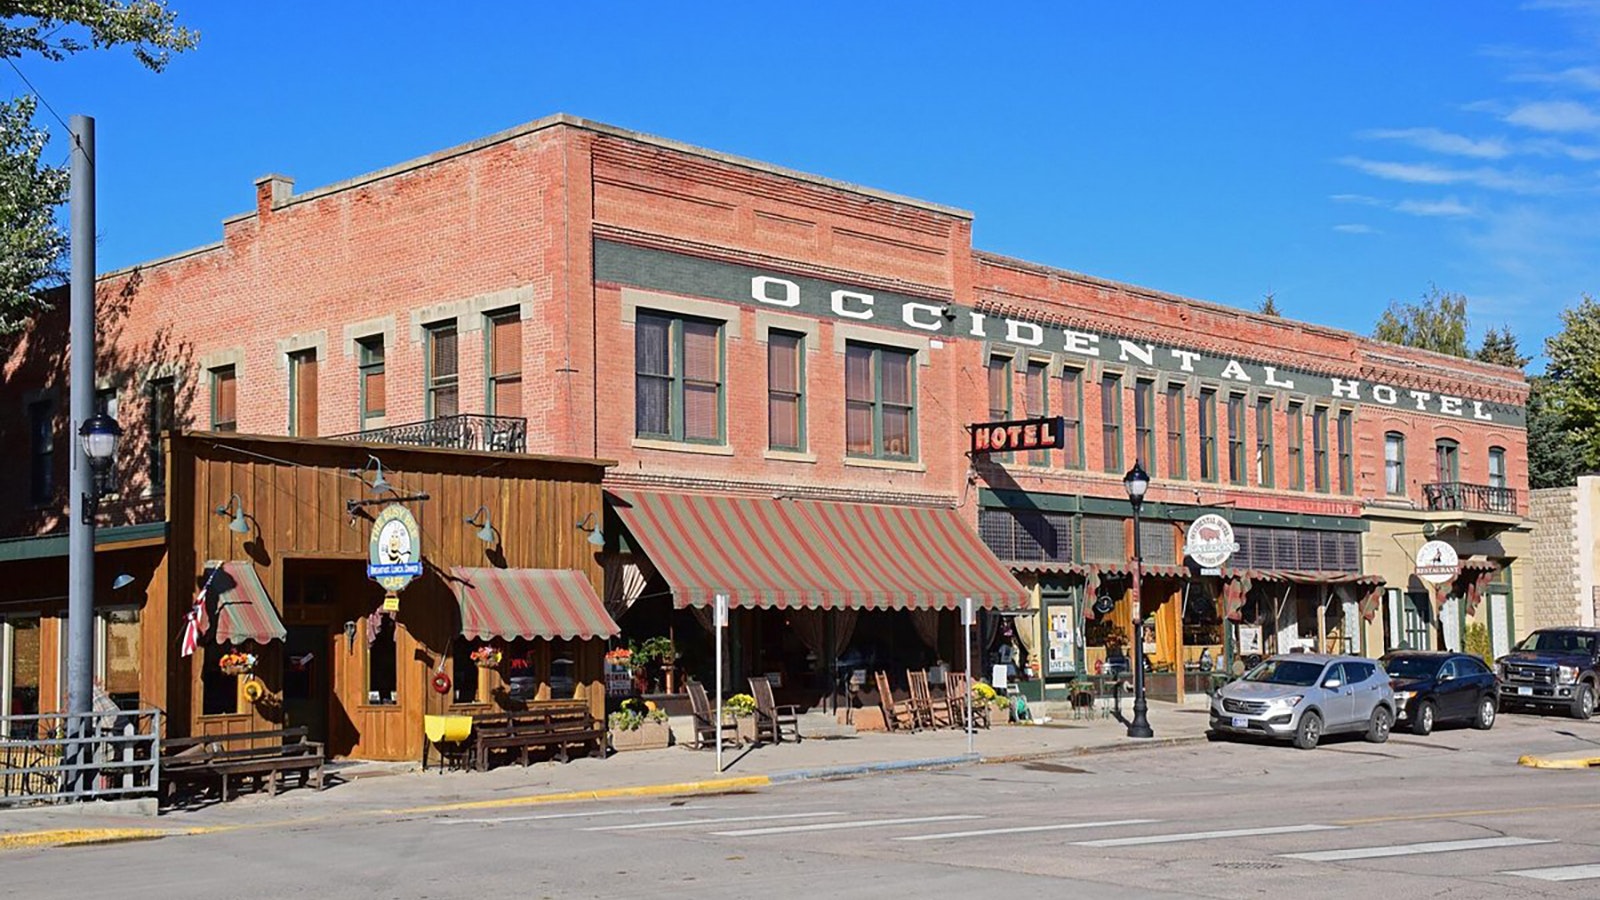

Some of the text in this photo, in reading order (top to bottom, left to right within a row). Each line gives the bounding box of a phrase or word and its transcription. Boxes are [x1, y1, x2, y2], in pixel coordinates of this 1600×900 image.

[751, 275, 1492, 421] OCCIDENTAL HOTEL
[975, 423, 1055, 450] HOTEL
[1416, 566, 1460, 575] RESTAURANT
